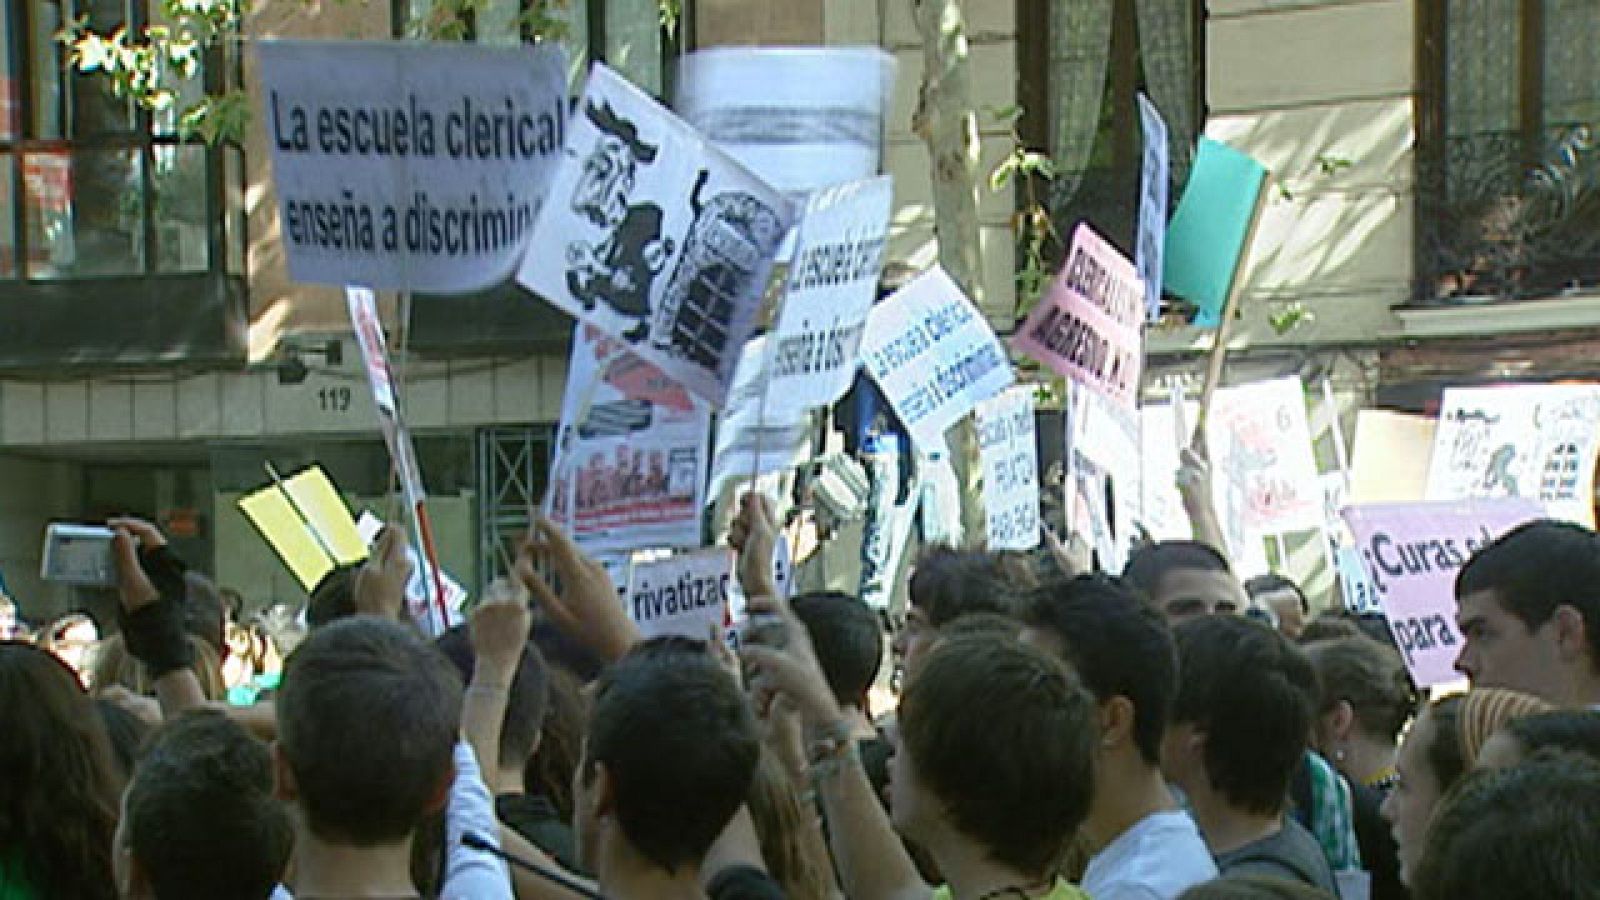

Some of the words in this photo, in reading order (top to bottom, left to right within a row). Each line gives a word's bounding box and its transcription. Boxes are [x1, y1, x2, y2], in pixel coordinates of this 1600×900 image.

[270, 89, 309, 151] La
[316, 92, 436, 157] escuela
[445, 94, 565, 161] clerical
[286, 189, 374, 249] enseña
[381, 203, 399, 252] a
[404, 190, 541, 257] discrimin
[317, 387, 352, 412] 119
[1393, 614, 1456, 666] para
